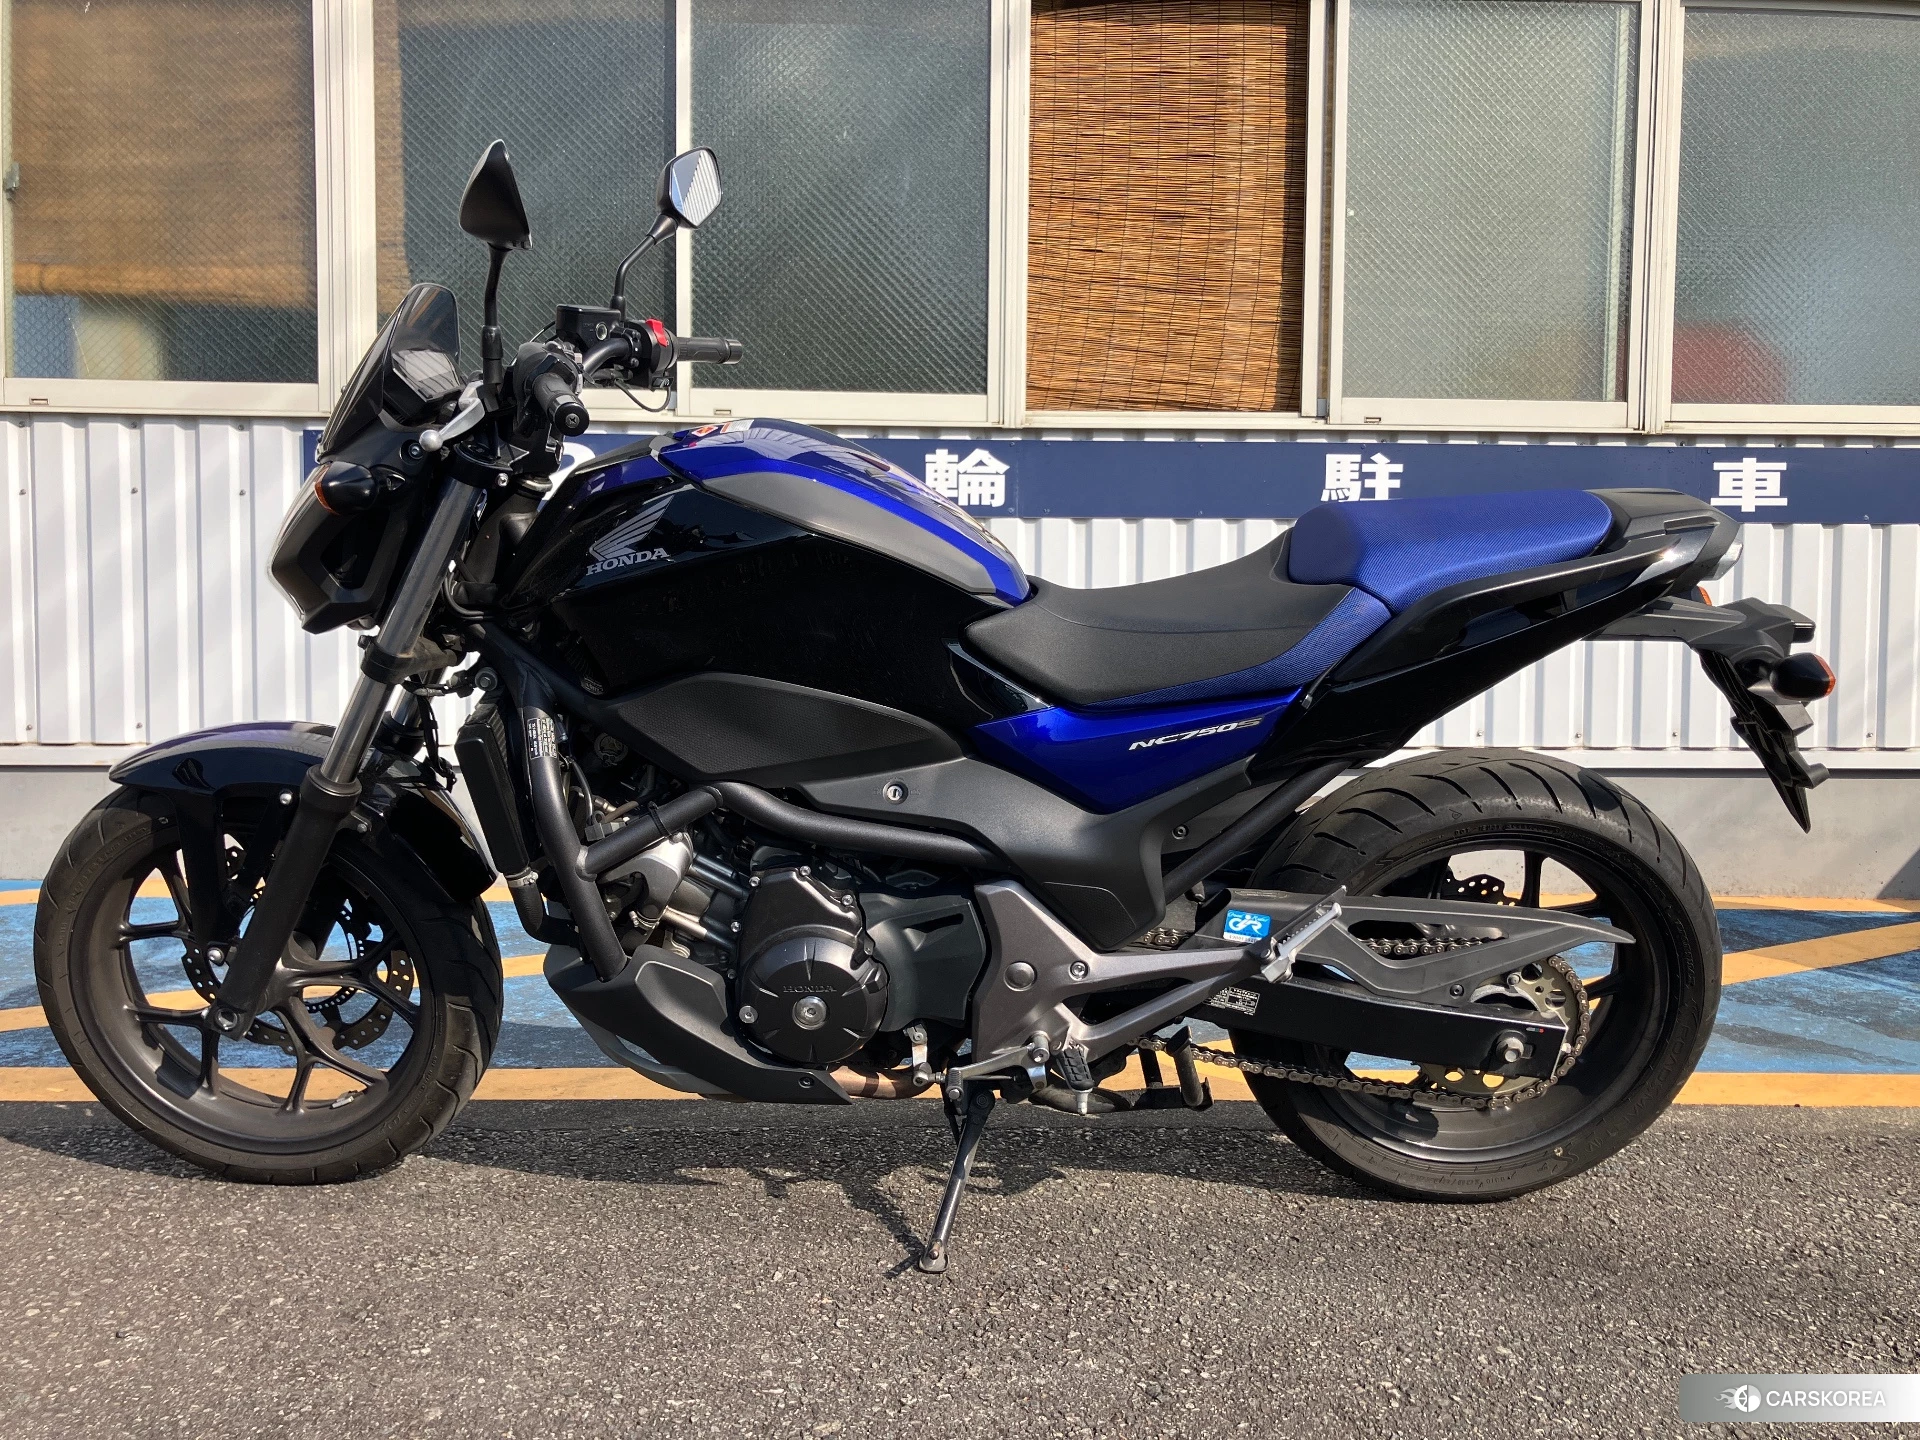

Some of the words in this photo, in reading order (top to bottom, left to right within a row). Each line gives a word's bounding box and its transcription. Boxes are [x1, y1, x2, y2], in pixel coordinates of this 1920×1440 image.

[1710, 457, 1788, 512] 車
[585, 547, 670, 576] HONDA
[1128, 717, 1263, 751] NC750S
[783, 985, 838, 993] HONDA
